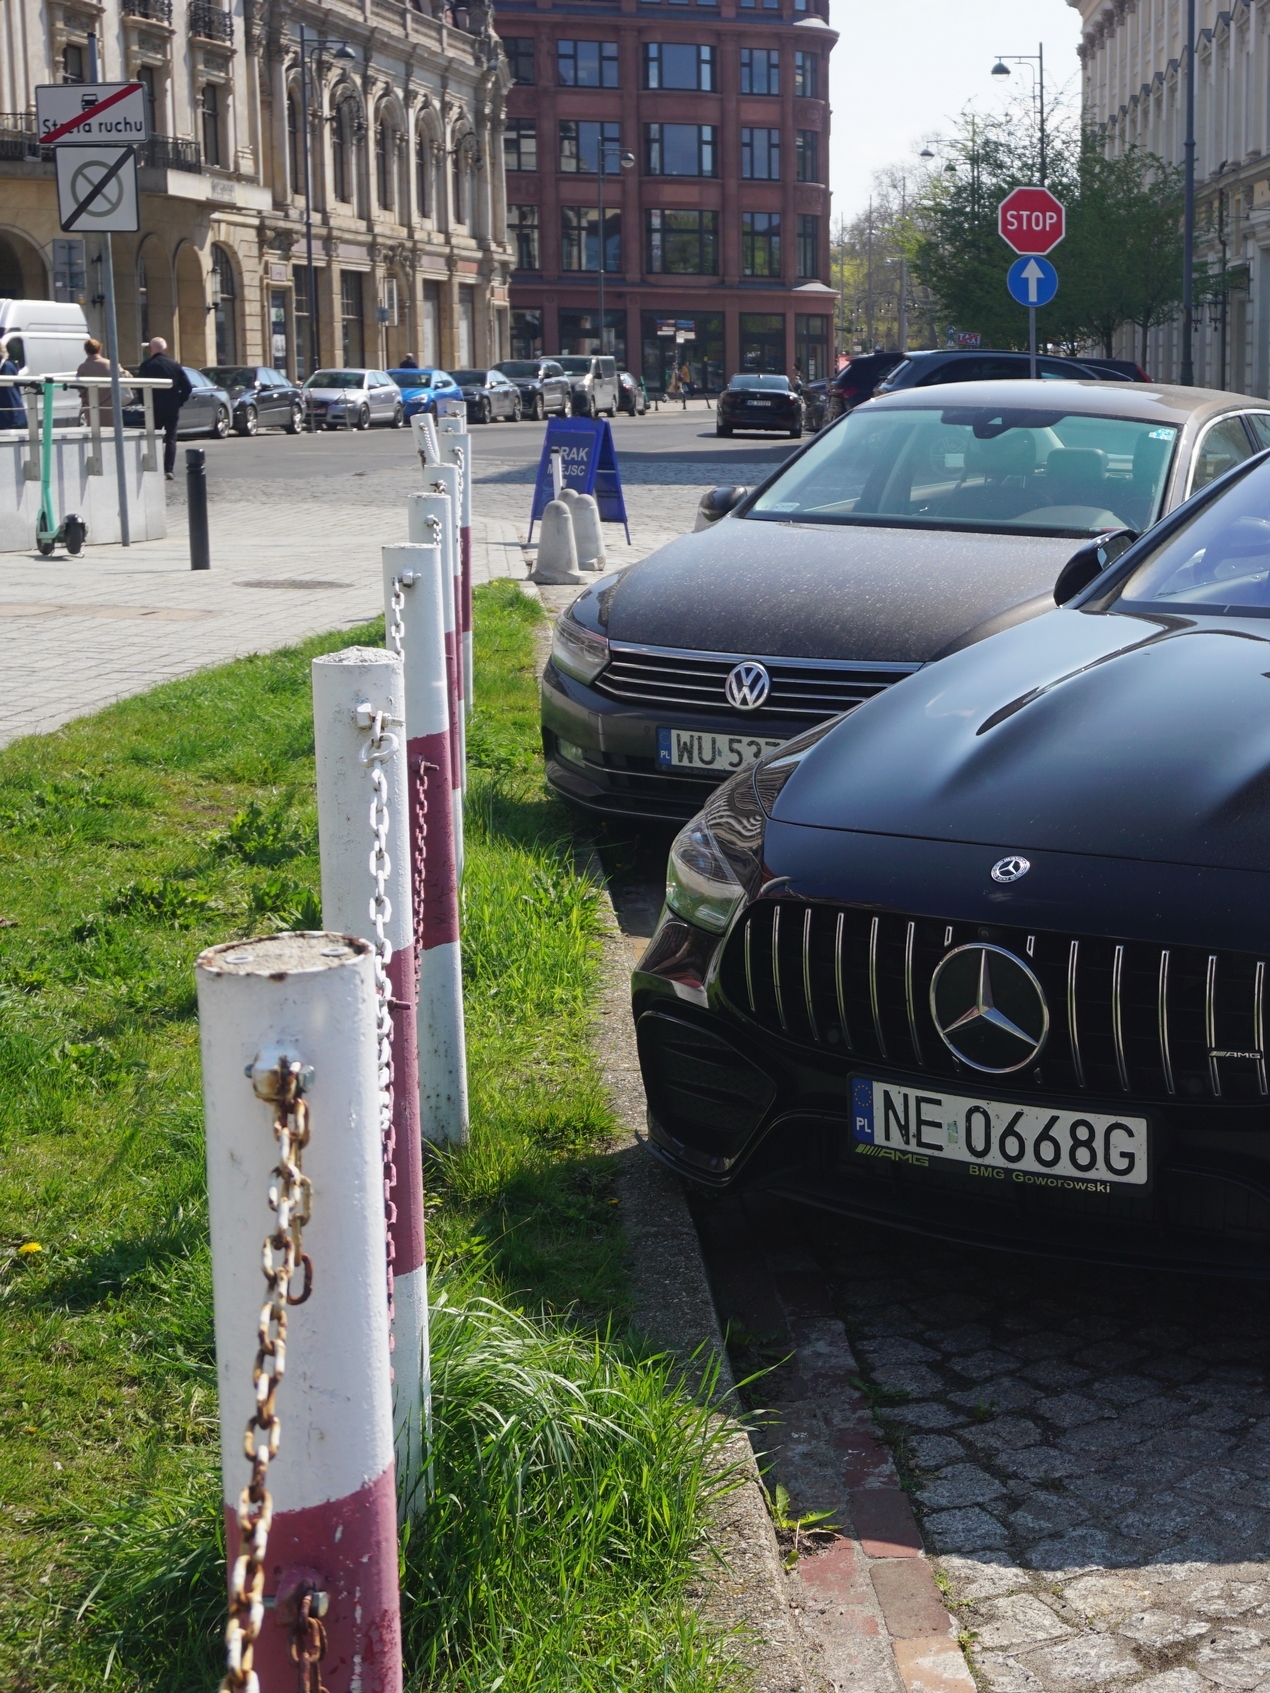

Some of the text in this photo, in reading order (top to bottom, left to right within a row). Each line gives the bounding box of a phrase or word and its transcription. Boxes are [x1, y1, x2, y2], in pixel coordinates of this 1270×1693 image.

[42, 117, 142, 134] Sta ruchu
[1006, 210, 1058, 231] STOP
[547, 463, 586, 476] MEJSC
[660, 750, 670, 759] PL
[676, 733, 781, 768] WU 53
[1224, 1051, 1261, 1059] AMG
[856, 1116, 872, 1133] PL
[883, 1089, 1136, 1177] NE 0668G
[881, 1148, 929, 1167] AMG
[968, 1164, 1111, 1194] BMG Goworowski
